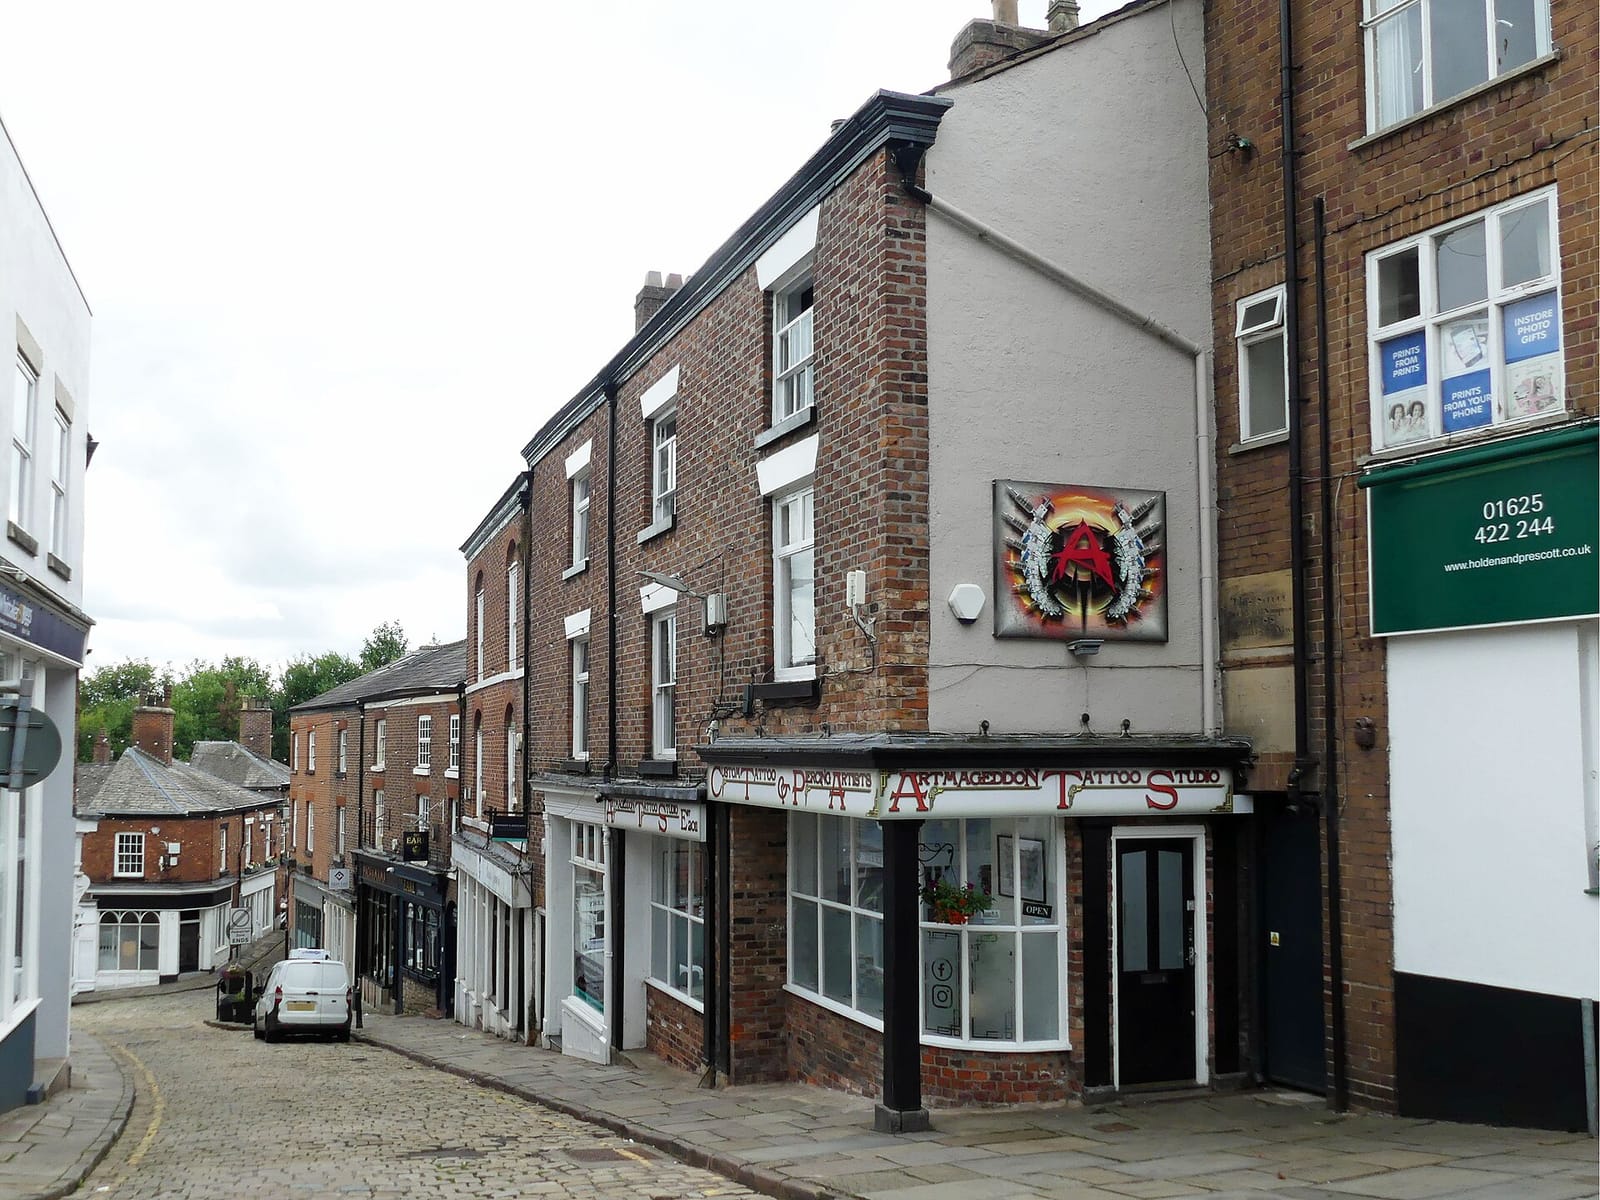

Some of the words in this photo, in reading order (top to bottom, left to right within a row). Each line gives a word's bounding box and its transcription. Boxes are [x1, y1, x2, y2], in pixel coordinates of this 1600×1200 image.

[1514, 309, 1553, 327] INSTORE
[1517, 320, 1550, 335] PHOTO
[1521, 331, 1548, 344] GIFTS
[1392, 346, 1420, 360] PRINTS
[1395, 356, 1418, 368] FROM
[1392, 364, 1420, 378] PRINTS
[1451, 387, 1481, 401] PRINTS
[1444, 400, 1467, 413] FROM
[1467, 393, 1493, 407] YOUR
[1452, 405, 1483, 419] PHONE
[1483, 494, 1544, 519] 01625
[1474, 523, 1510, 544] 422
[1516, 516, 1555, 539] 244
[1444, 544, 1591, 572] www.holdenandprescott.co.uk
[741, 767, 777, 800] TATTOO
[828, 771, 872, 811] ARTISTS
[1042, 770, 1141, 810] TATTOO
[1146, 770, 1220, 810] STUDIO
[1026, 905, 1049, 916] OPEN
